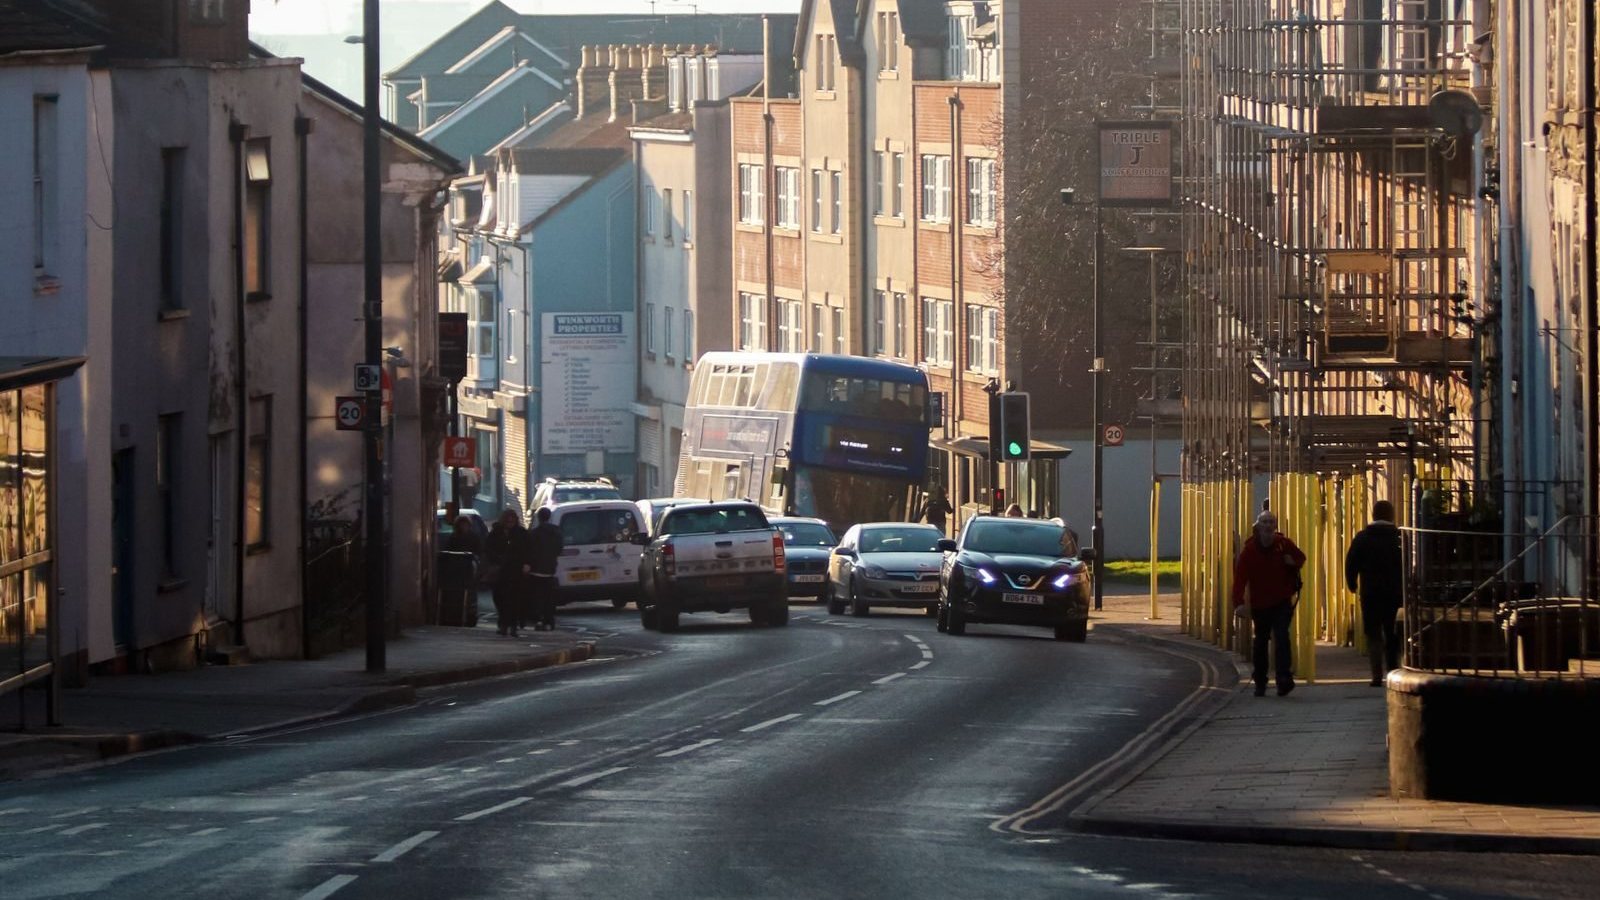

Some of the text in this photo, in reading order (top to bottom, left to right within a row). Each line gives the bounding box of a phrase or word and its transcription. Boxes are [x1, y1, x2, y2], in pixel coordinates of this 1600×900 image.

[1111, 132, 1160, 143] TRIPLE
[1130, 147, 1144, 165] J
[557, 316, 620, 324] WINKWORTH
[557, 325, 619, 333] PROPERTIES
[340, 407, 360, 420] 20
[1107, 430, 1121, 439] 20
